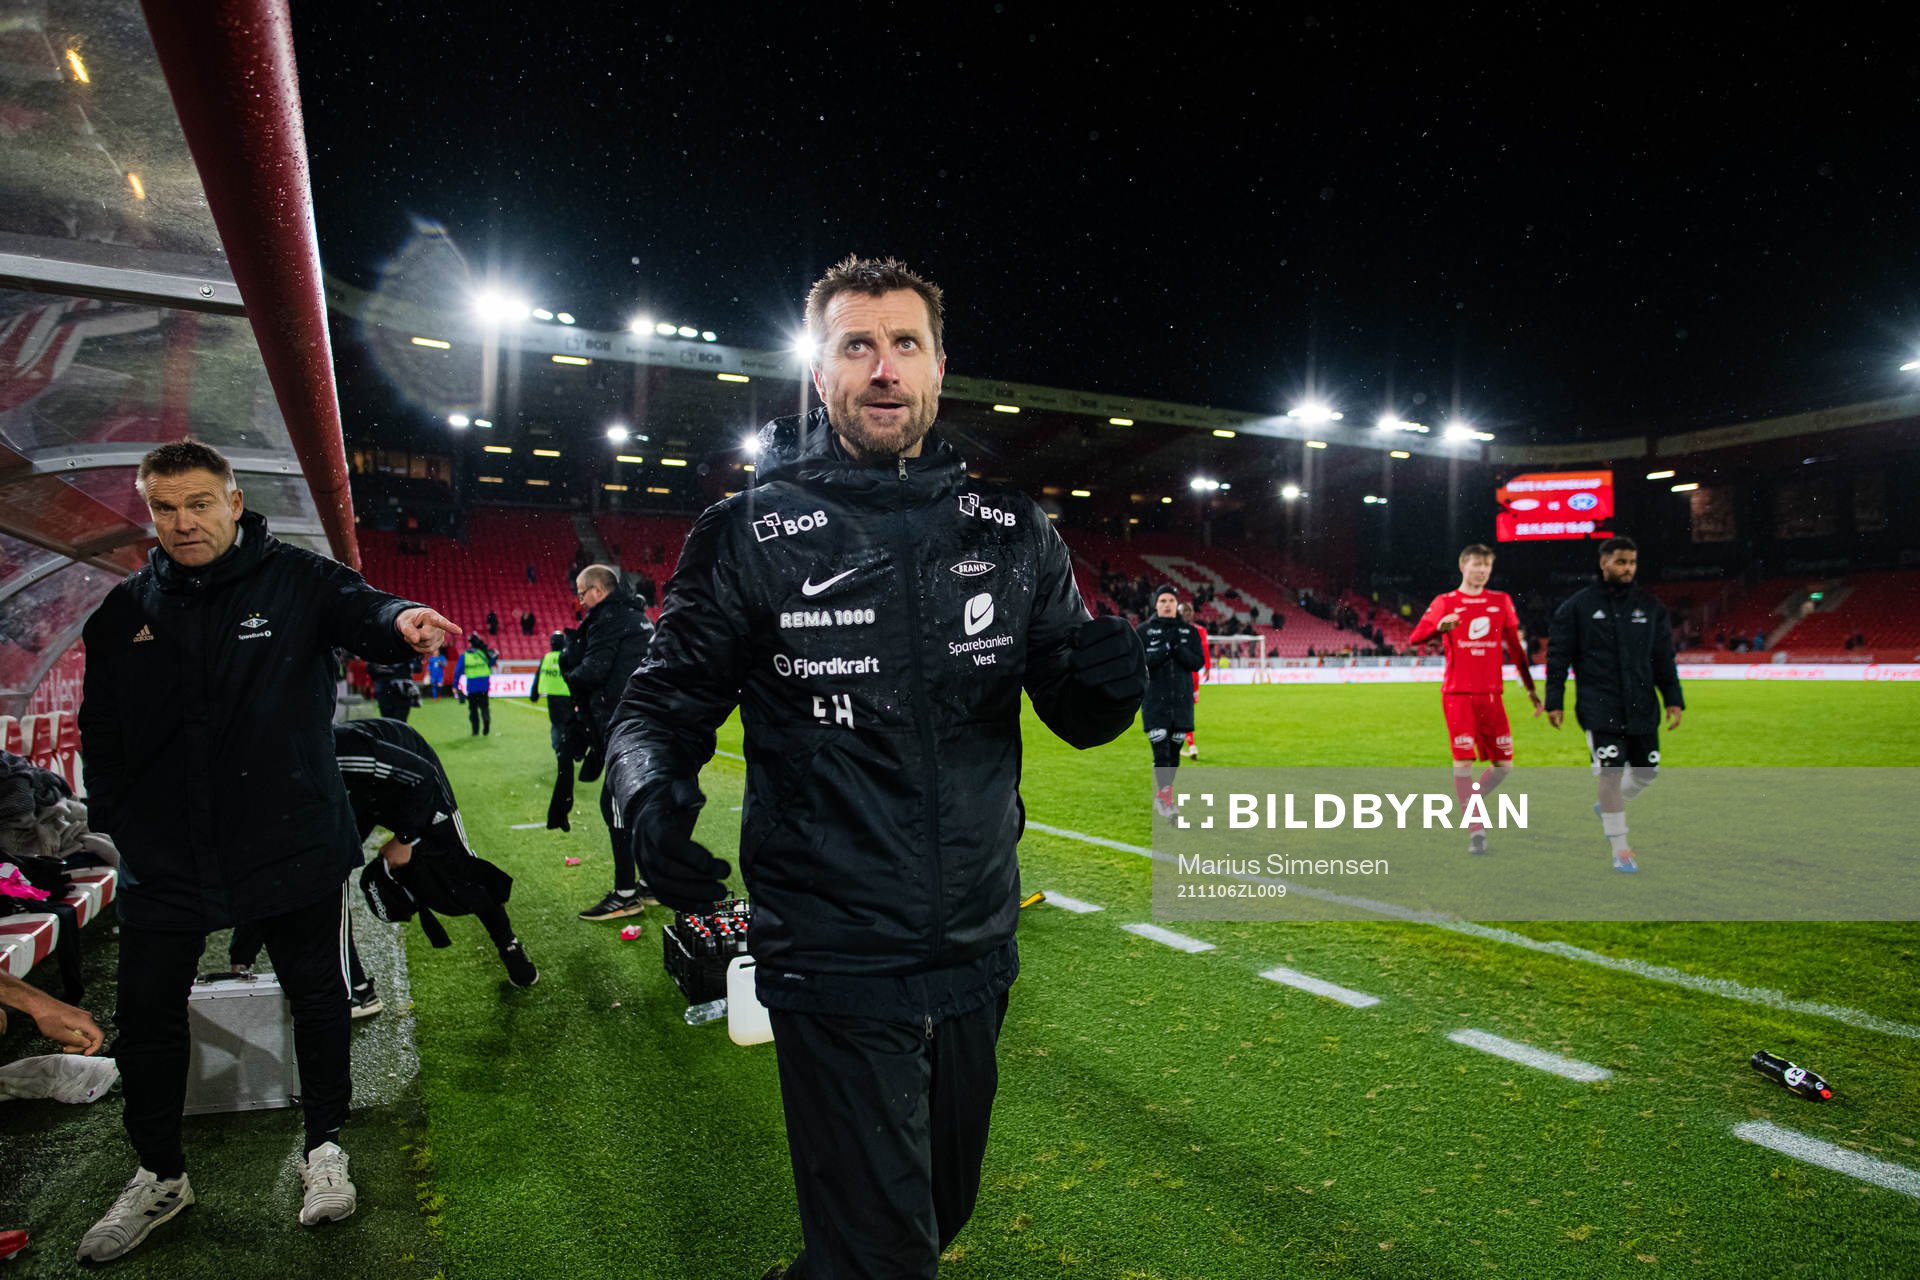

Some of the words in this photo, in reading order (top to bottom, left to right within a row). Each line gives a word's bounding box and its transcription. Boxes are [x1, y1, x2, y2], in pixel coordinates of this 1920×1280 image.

[782, 510, 828, 536] BOB
[980, 506, 1016, 527] BOB
[958, 564, 987, 573] BRANN
[780, 610, 833, 628] REMA
[834, 608, 876, 626] 1000
[948, 635, 1013, 657] Sparebanken
[793, 656, 880, 679] Fjordkraft
[972, 653, 997, 666] Vest
